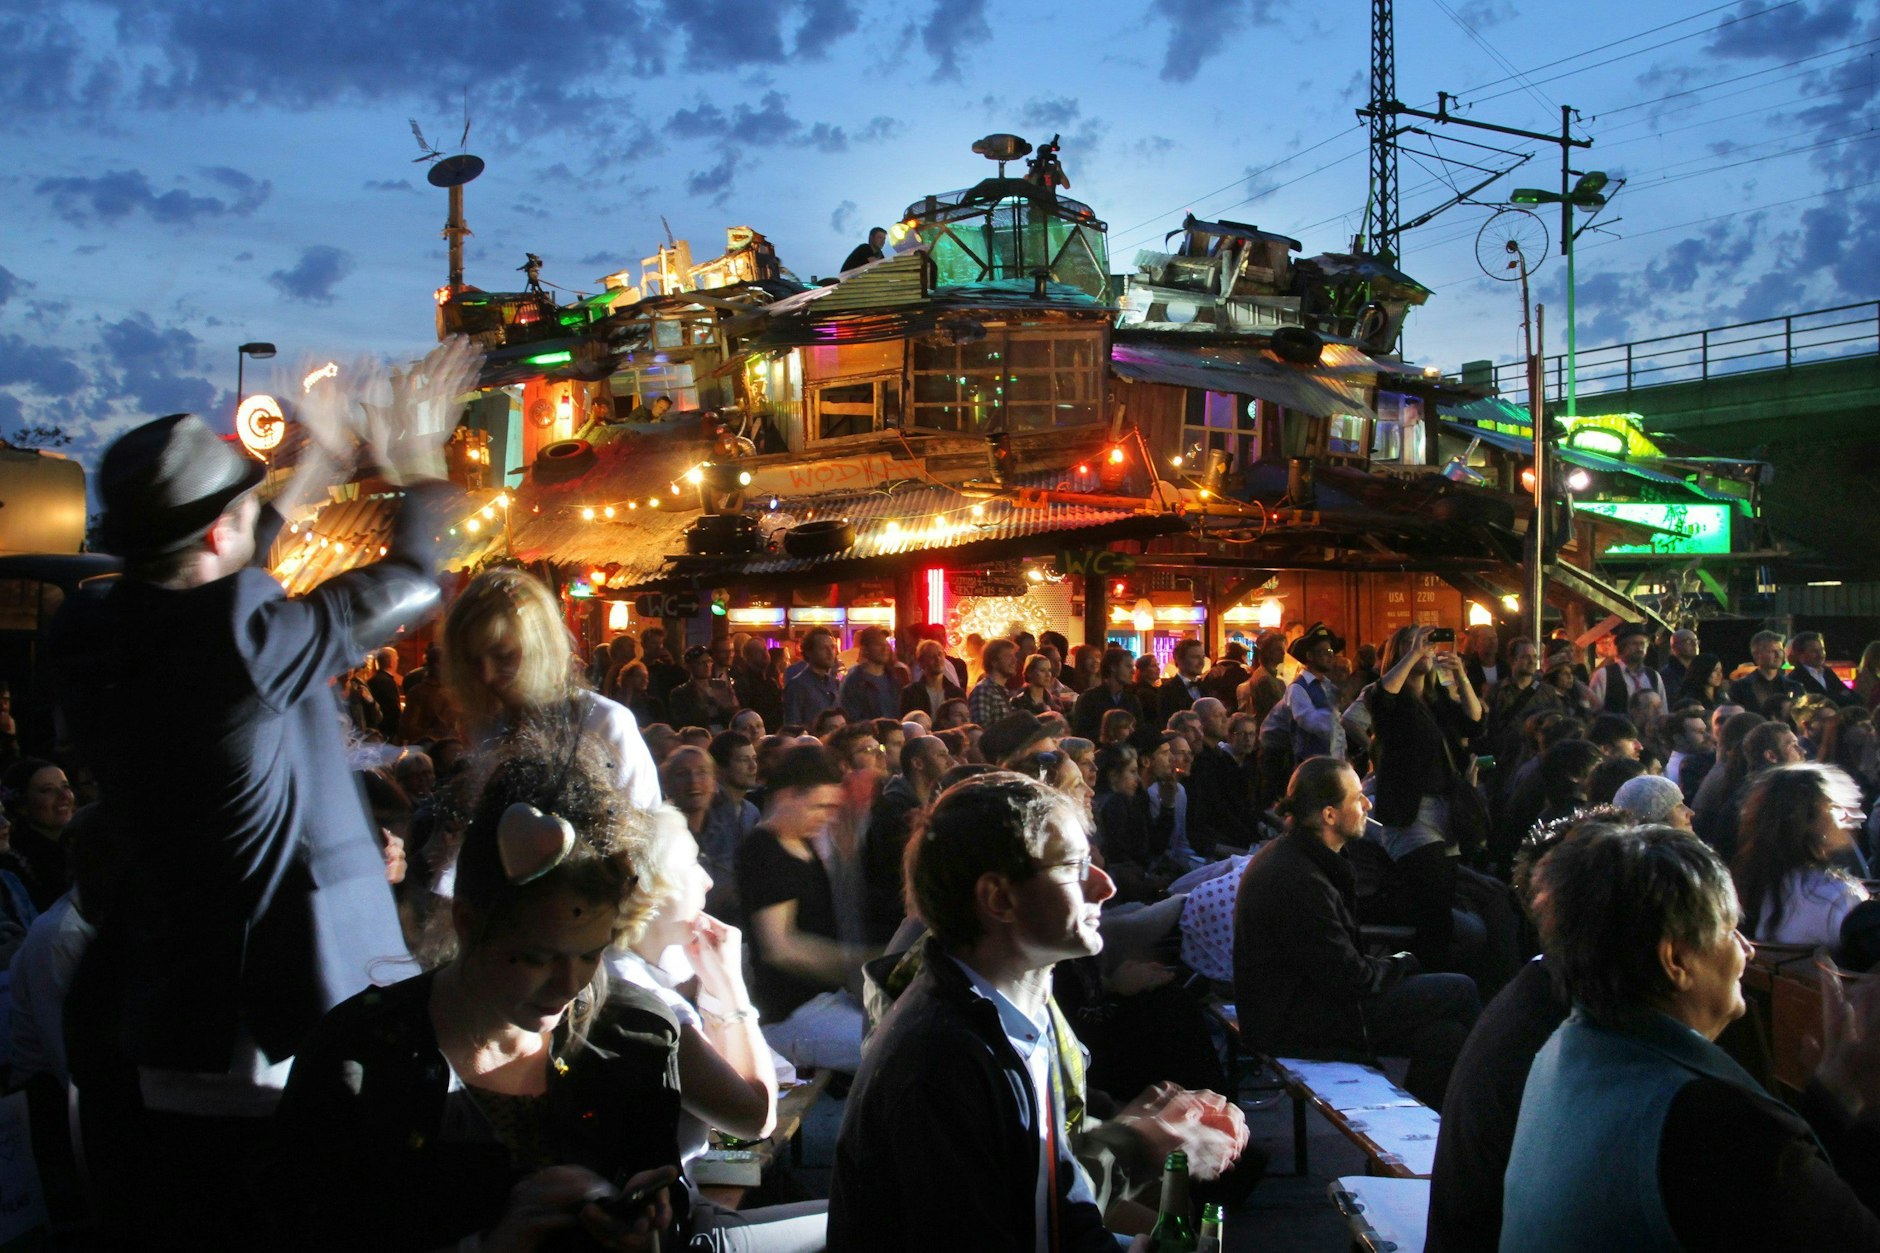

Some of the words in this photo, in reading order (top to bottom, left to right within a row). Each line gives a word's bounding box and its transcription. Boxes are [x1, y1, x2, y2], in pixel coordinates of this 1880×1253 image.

[1064, 549, 1116, 574] WC
[648, 594, 678, 616] WC
[1389, 591, 1404, 603] USA
[1417, 591, 1435, 603] 2210
